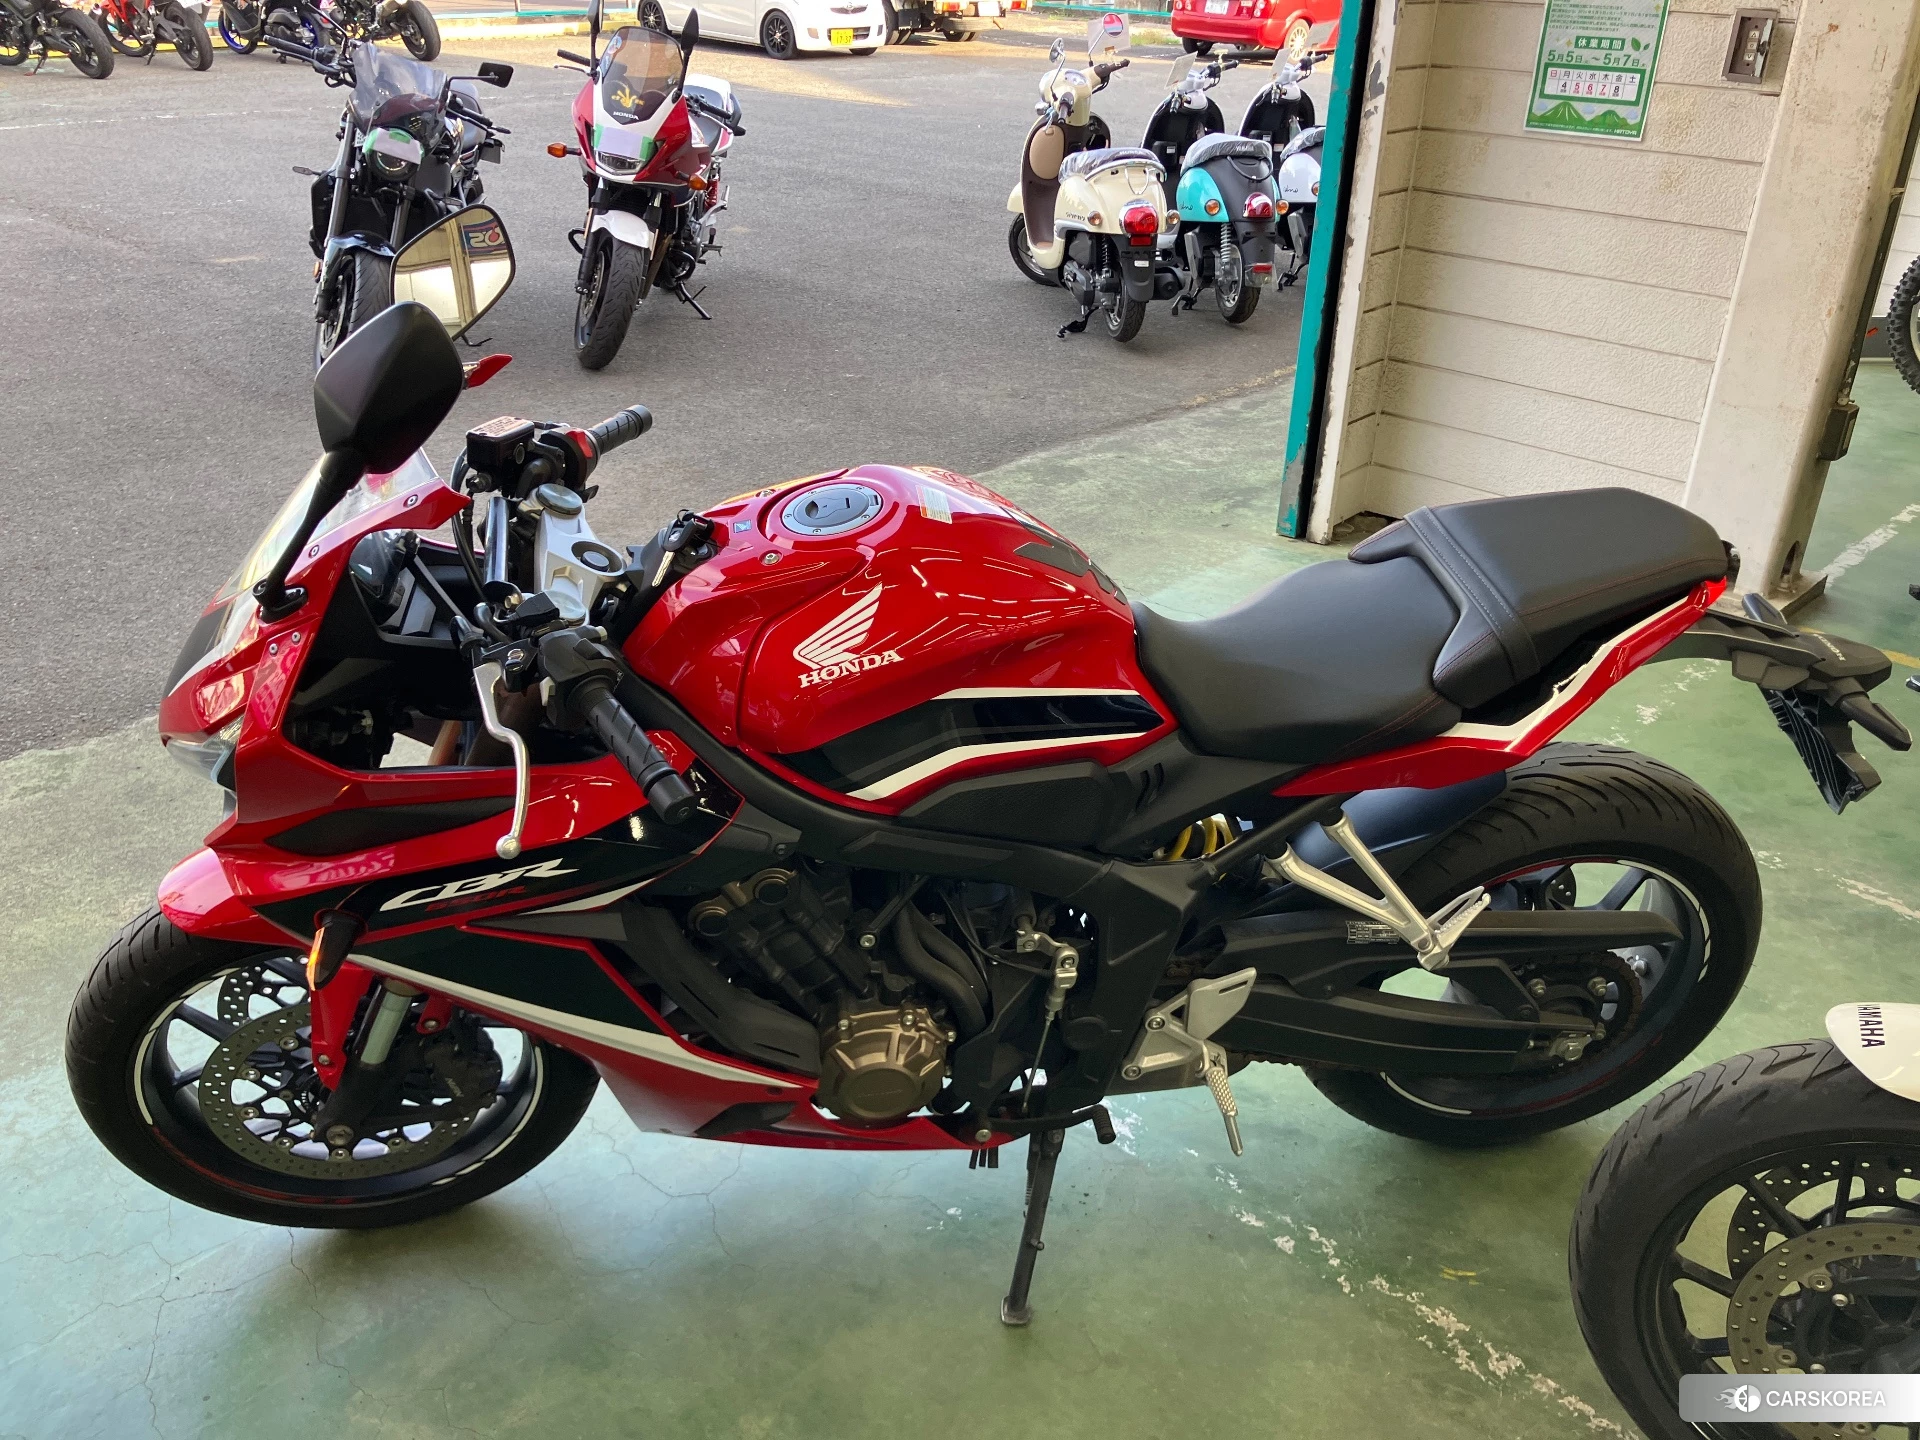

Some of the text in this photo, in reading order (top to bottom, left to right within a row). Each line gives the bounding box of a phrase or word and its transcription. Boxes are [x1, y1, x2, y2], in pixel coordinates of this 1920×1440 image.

[1577, 37, 1622, 50] 休業期間
[1563, 71, 1571, 79] 月
[1602, 73, 1610, 81] 木
[1615, 74, 1623, 82] 金
[1629, 75, 1637, 83] 土
[1575, 82, 1580, 90] 5
[1588, 83, 1593, 91] 6
[1601, 84, 1606, 92] 7
[1614, 85, 1620, 93] 8
[613, 111, 639, 121] HONDA
[798, 650, 904, 688] HONDA
[380, 858, 579, 912] CBR
